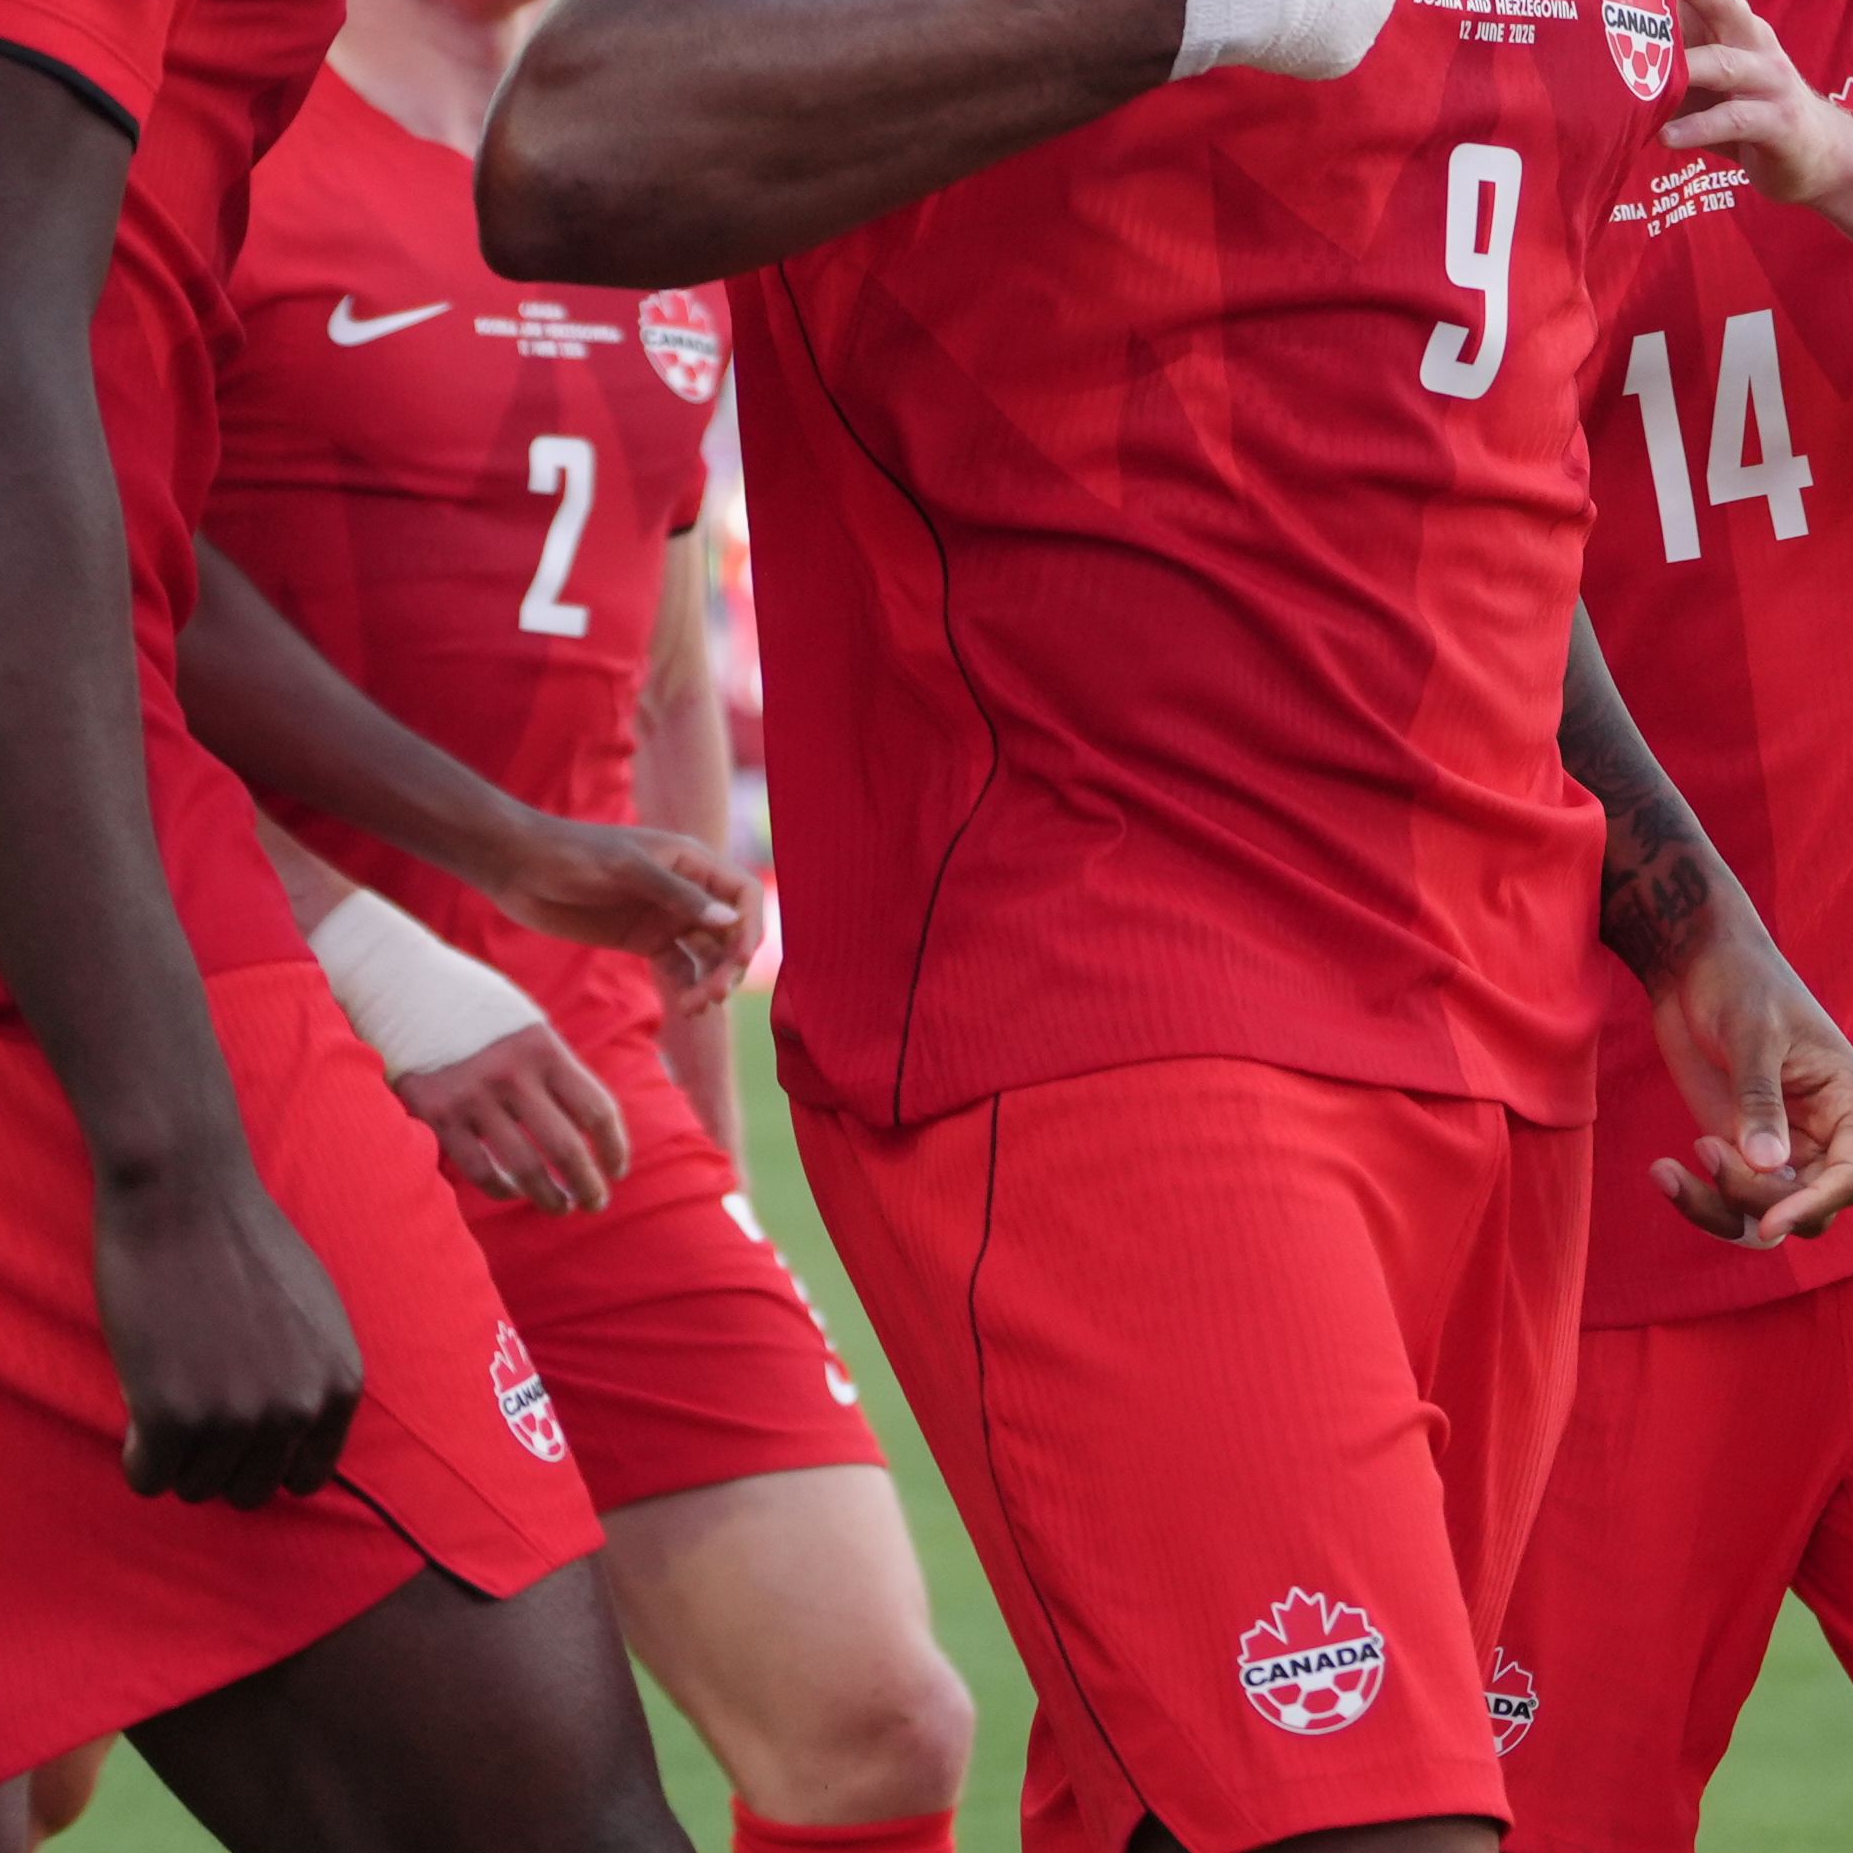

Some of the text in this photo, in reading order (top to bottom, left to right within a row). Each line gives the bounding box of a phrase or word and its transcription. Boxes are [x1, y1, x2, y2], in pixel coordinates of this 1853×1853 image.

[1459, 20, 1535, 45] 12 JUNE 2026
[1604, 4, 1671, 43] CANADA
[1650, 157, 1706, 194] CANADA
[1647, 190, 1736, 238] 12 JUNE 2026
[1651, 192, 1680, 217] AND
[1419, 142, 1522, 400] 9
[1622, 308, 1814, 564] 14
[518, 435, 596, 639] 2
[1244, 1642, 1380, 1687] CANADA
